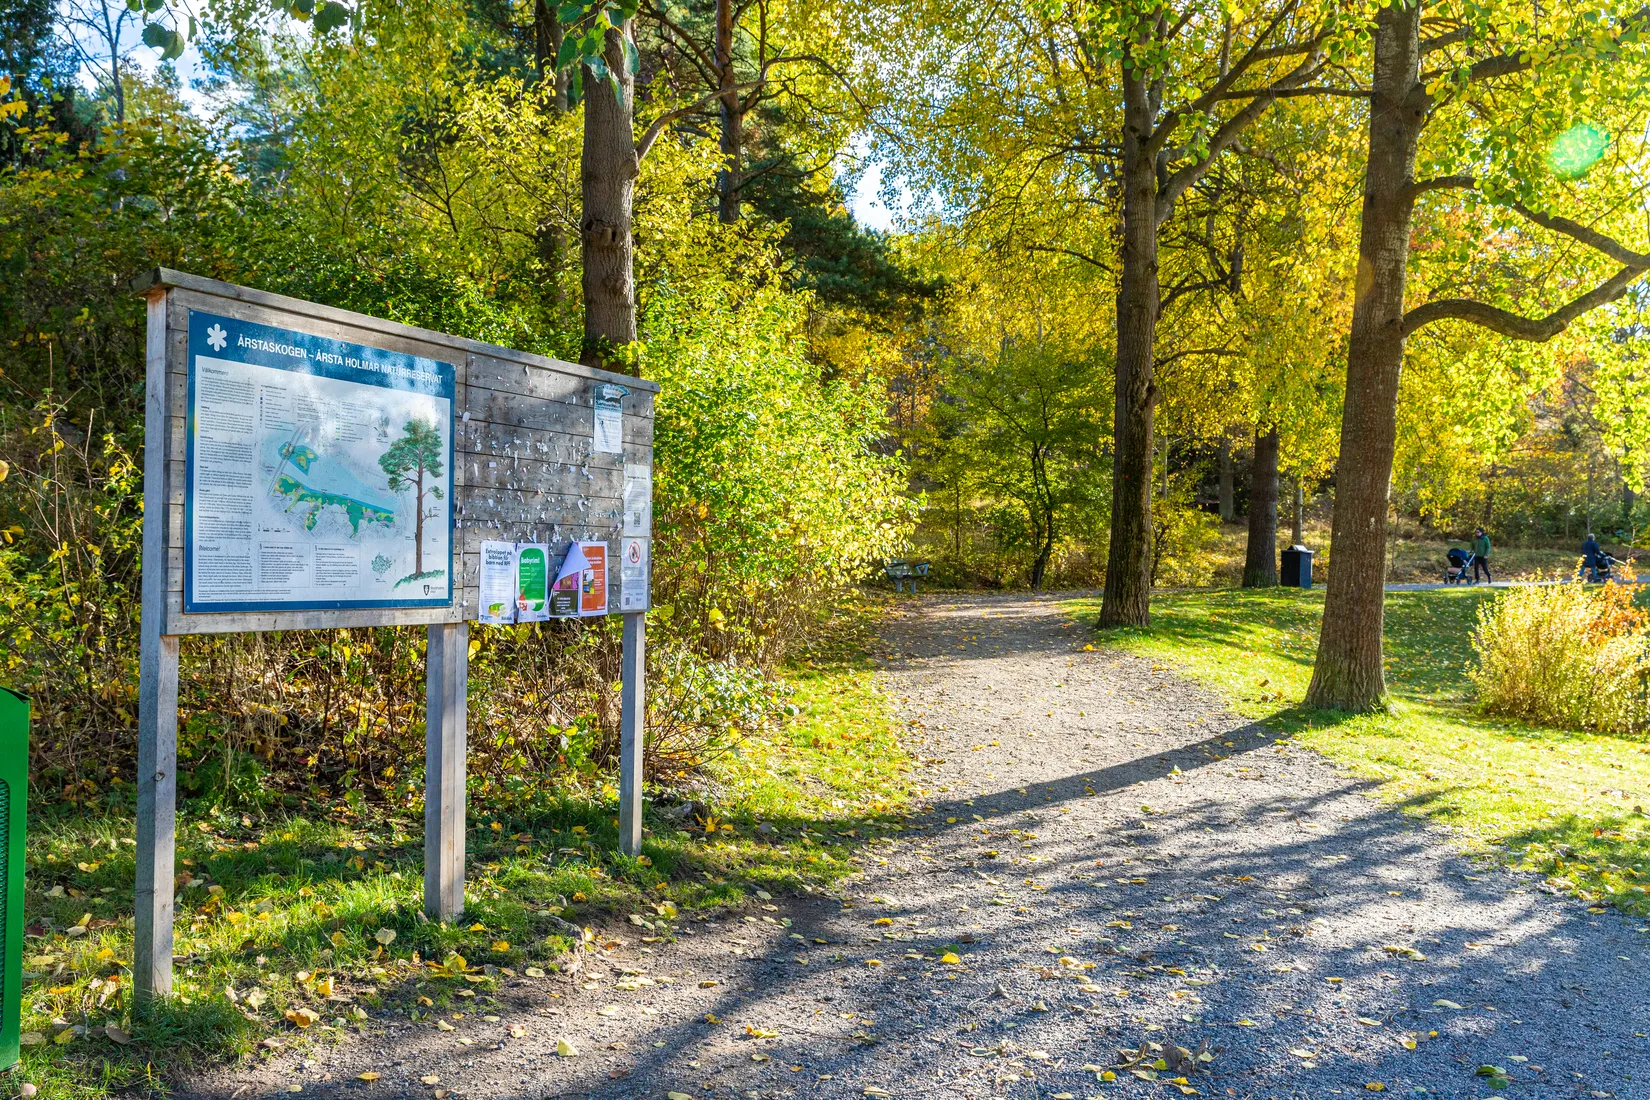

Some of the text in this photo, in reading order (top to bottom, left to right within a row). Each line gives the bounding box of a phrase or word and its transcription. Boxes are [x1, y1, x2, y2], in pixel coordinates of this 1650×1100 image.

[237, 333, 306, 359] ÅRSTASKOGEN
[315, 349, 343, 366] ÅRSTA
[345, 357, 380, 373] HOLMAR
[381, 364, 443, 384] NATURRESERVAT
